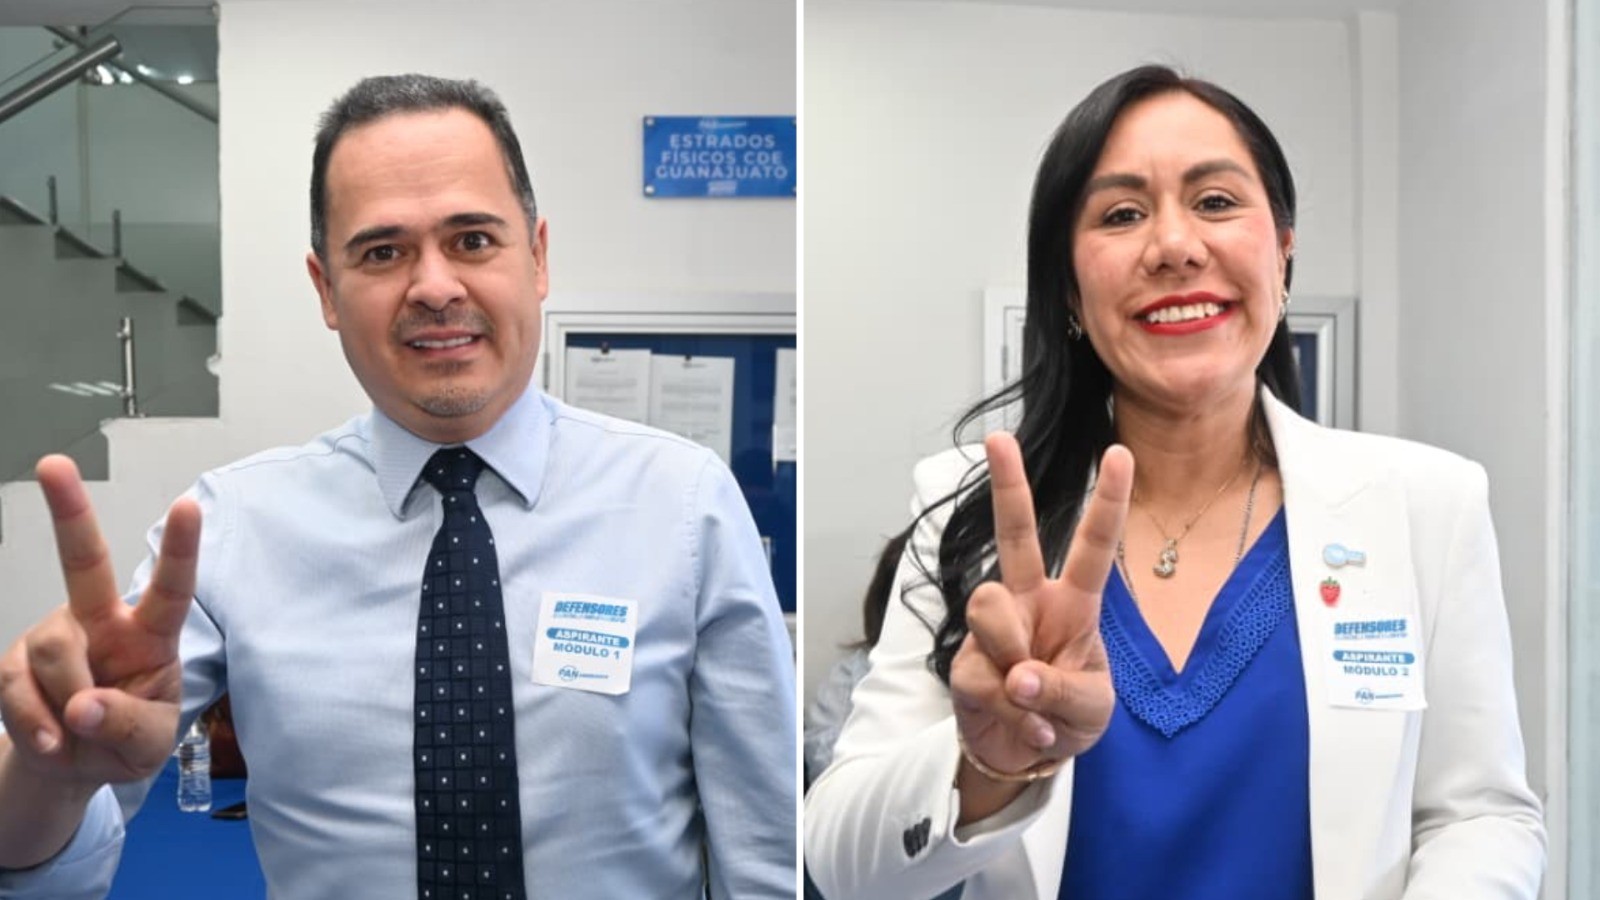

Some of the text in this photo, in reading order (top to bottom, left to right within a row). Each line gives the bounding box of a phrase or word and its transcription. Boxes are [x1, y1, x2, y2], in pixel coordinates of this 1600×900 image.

[670, 134, 775, 148] ESTRADOS
[661, 148, 783, 165] FÍSICOS CDE
[656, 165, 787, 178] GUANAJUATO
[554, 601, 628, 617] DEFENSORES
[1334, 619, 1407, 636] DEFENSORES
[555, 629, 620, 646] ASPIRANTE
[613, 650, 620, 659] 1
[1342, 651, 1406, 664] ASPIRANTE
[1402, 667, 1410, 677] 2
